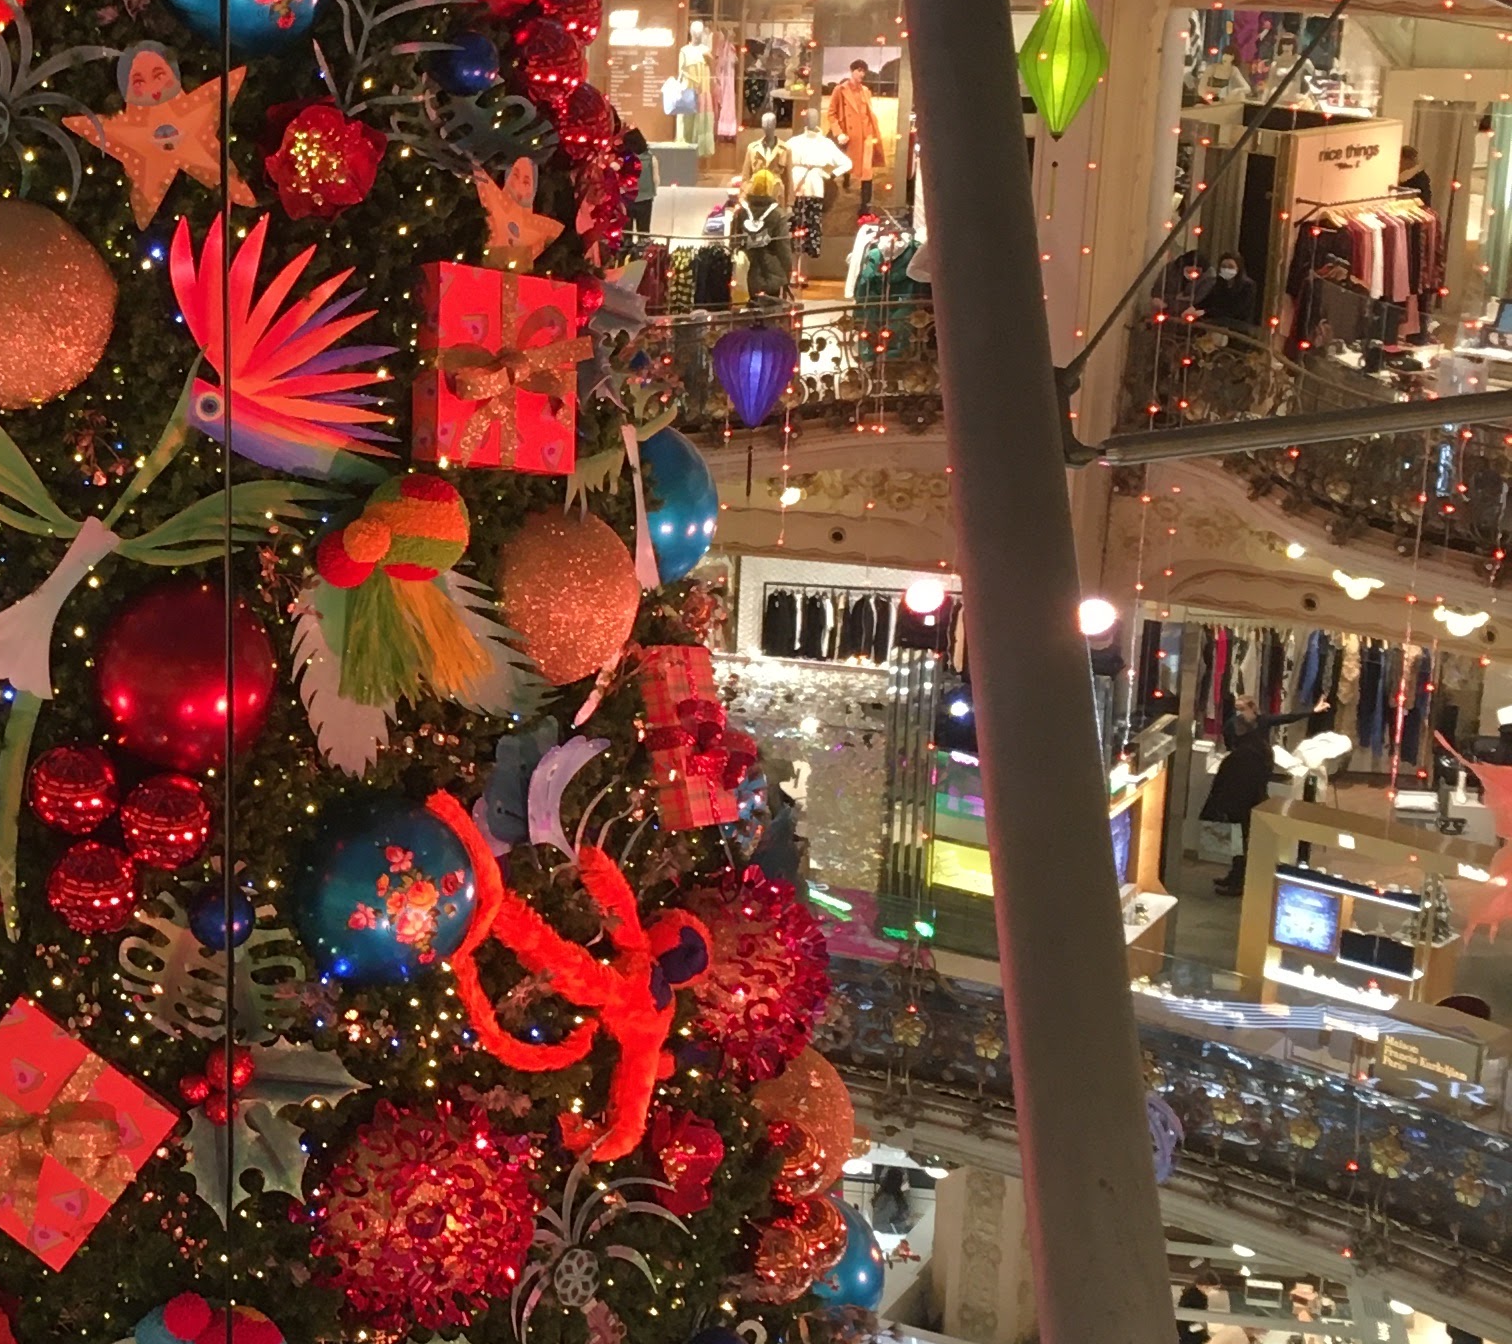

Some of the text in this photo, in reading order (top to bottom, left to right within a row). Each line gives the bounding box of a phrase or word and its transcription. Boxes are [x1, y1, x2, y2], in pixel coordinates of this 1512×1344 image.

[1318, 143, 1380, 162] nice things
[1384, 1034, 1420, 1055] Maison
